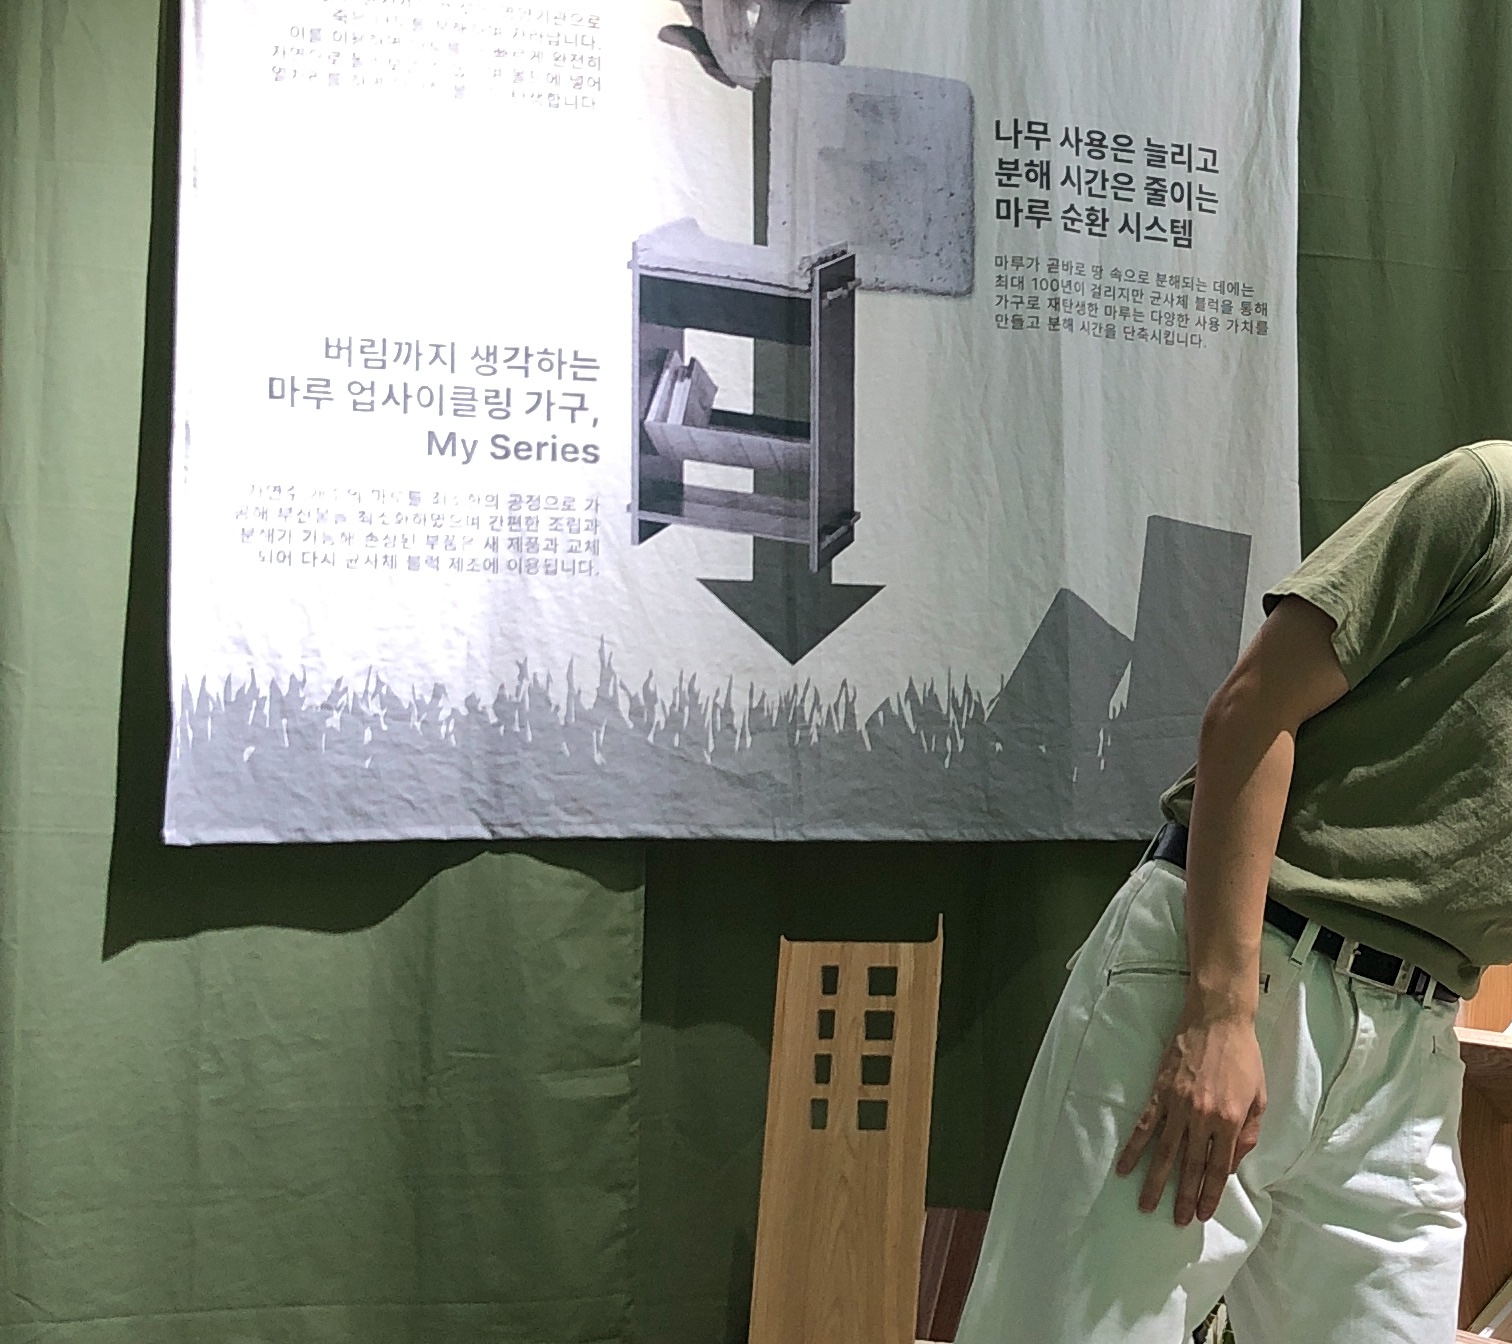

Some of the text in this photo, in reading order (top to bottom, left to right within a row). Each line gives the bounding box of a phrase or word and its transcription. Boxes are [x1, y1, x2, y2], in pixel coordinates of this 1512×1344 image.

[994, 118, 1219, 174] 나무 사용은 늘리고
[995, 157, 1219, 215] 분해 시간은 줄이는
[995, 196, 1193, 249] 마루 순환 시스템
[994, 255, 1040, 272] 마루가
[1046, 258, 1086, 277] 곧바로
[1110, 267, 1151, 285] 속으로
[1155, 272, 1208, 294] 분해되는
[1212, 280, 1255, 298] 데에는
[995, 274, 1025, 291] 최대
[1031, 278, 1085, 296] 100년이
[1090, 285, 1144, 304] 걸리지만
[1149, 291, 1189, 309] 균사체
[995, 295, 1040, 311] 가구로
[1047, 296, 1099, 317] 재탄생한
[1104, 305, 1145, 323] 마루는
[1150, 310, 1190, 329] 다양한
[1194, 316, 1220, 332] 사용
[995, 314, 1040, 331] 만들고
[1047, 316, 1074, 333] 분해
[1079, 321, 1116, 340] 시간을
[324, 335, 601, 382] 버림까지 생각하는
[269, 375, 599, 428] 마루 업사이클링 가구,
[427, 431, 601, 465] My Series
[488, 514, 540, 535] 간편한
[548, 515, 600, 537] 조립과
[301, 550, 336, 568] 다시
[448, 553, 499, 574] 제조에
[484, 533, 499, 554] 새
[507, 534, 559, 555] 제품과
[567, 537, 601, 557] 교체
